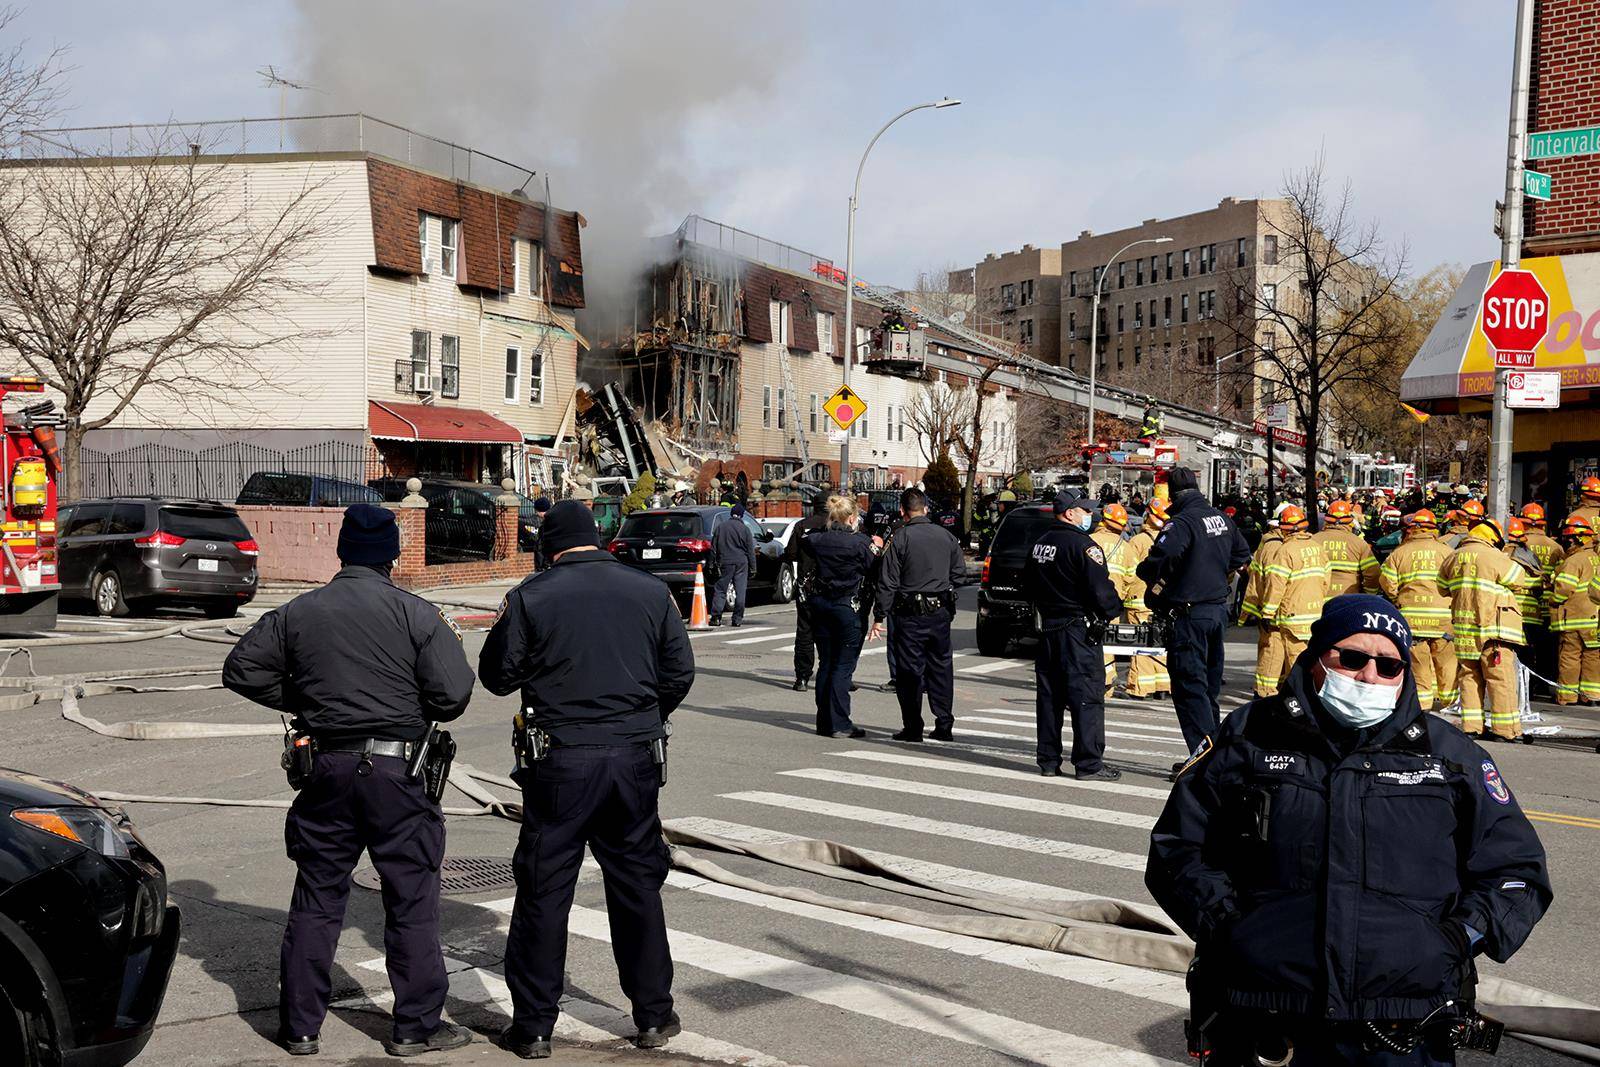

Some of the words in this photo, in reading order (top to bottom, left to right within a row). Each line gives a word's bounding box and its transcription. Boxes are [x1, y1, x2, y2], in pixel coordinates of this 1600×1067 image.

[1526, 173, 1540, 194] Fox
[1542, 177, 1547, 188] St
[1486, 296, 1545, 330] STOP
[895, 342, 903, 351] 31
[1498, 353, 1512, 364] ALL
[1516, 354, 1532, 365] WAY
[1561, 369, 1579, 386] EER
[1586, 367, 1600, 384] SO
[1202, 515, 1226, 531] NYPD
[1032, 544, 1057, 558] NYPD
[1323, 540, 1347, 551] FDNY
[1530, 545, 1551, 555] FDNY
[1411, 550, 1437, 561] FDNY
[1458, 551, 1479, 564] DNY
[1412, 560, 1437, 571] EMS
[1410, 618, 1440, 626] SANTIAGO
[1288, 700, 1301, 713] S4
[1407, 726, 1420, 738] S4
[1264, 755, 1295, 764] LICATA
[1269, 762, 1289, 770] 6437
